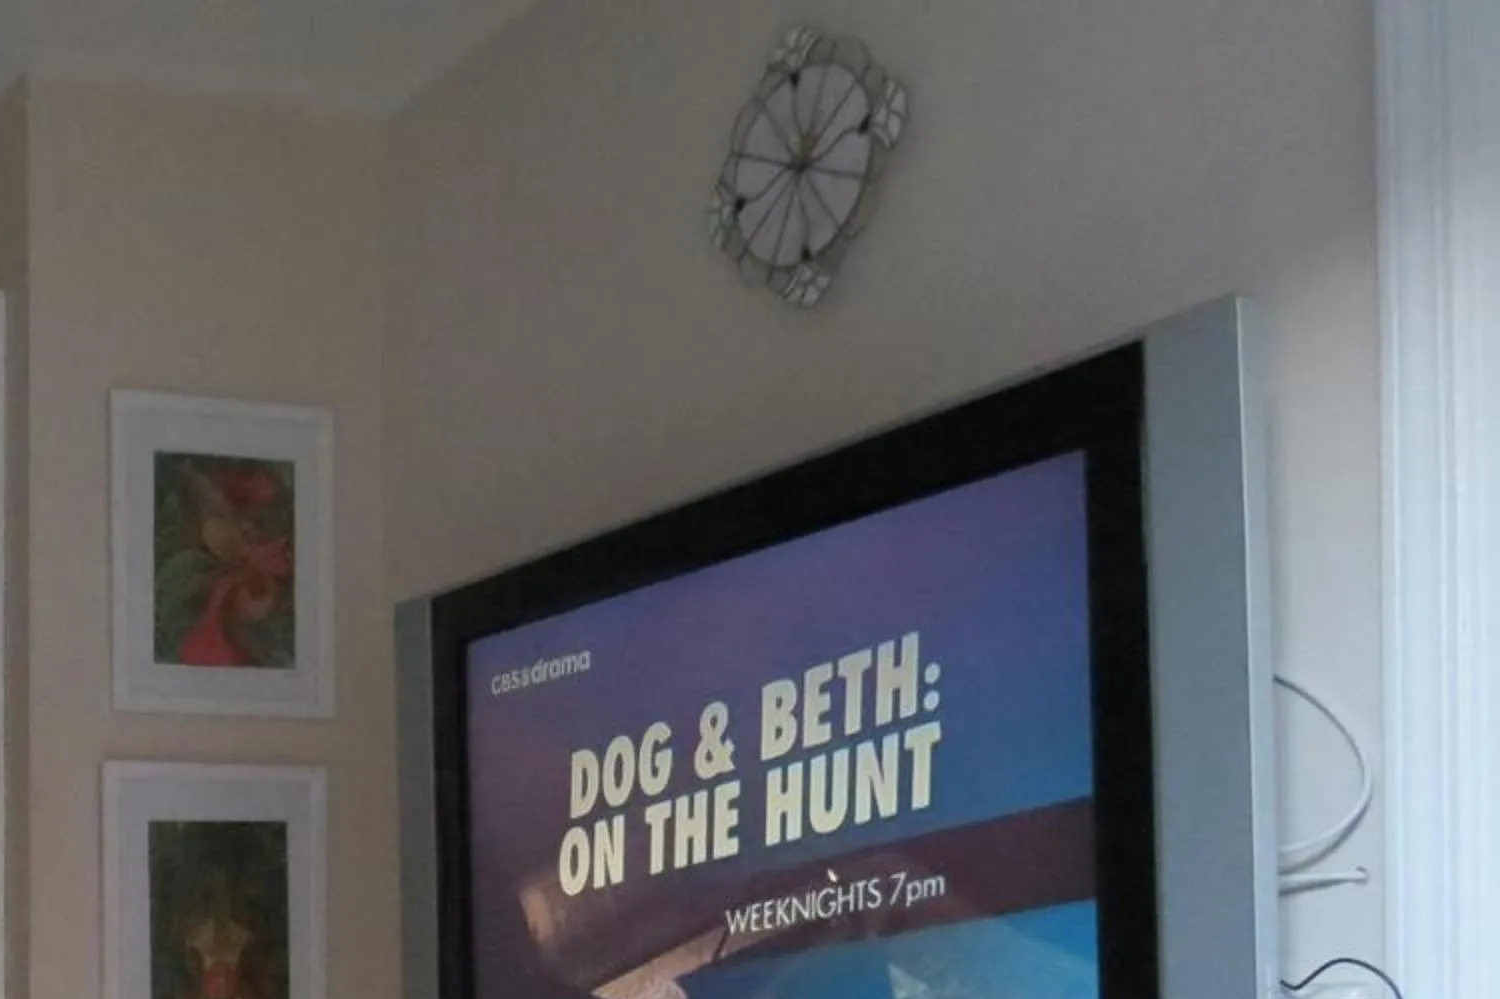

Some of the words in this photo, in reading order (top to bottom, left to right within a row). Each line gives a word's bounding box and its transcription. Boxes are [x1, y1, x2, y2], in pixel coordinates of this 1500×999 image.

[558, 813, 625, 897] ON
[645, 780, 741, 876] THE
[765, 722, 942, 847] HUNT
[570, 721, 673, 819] DOG
[694, 701, 735, 779] &
[760, 631, 942, 761] BETH:
[725, 876, 883, 935] WEEKNIGHTS
[889, 871, 946, 908] 7pm
